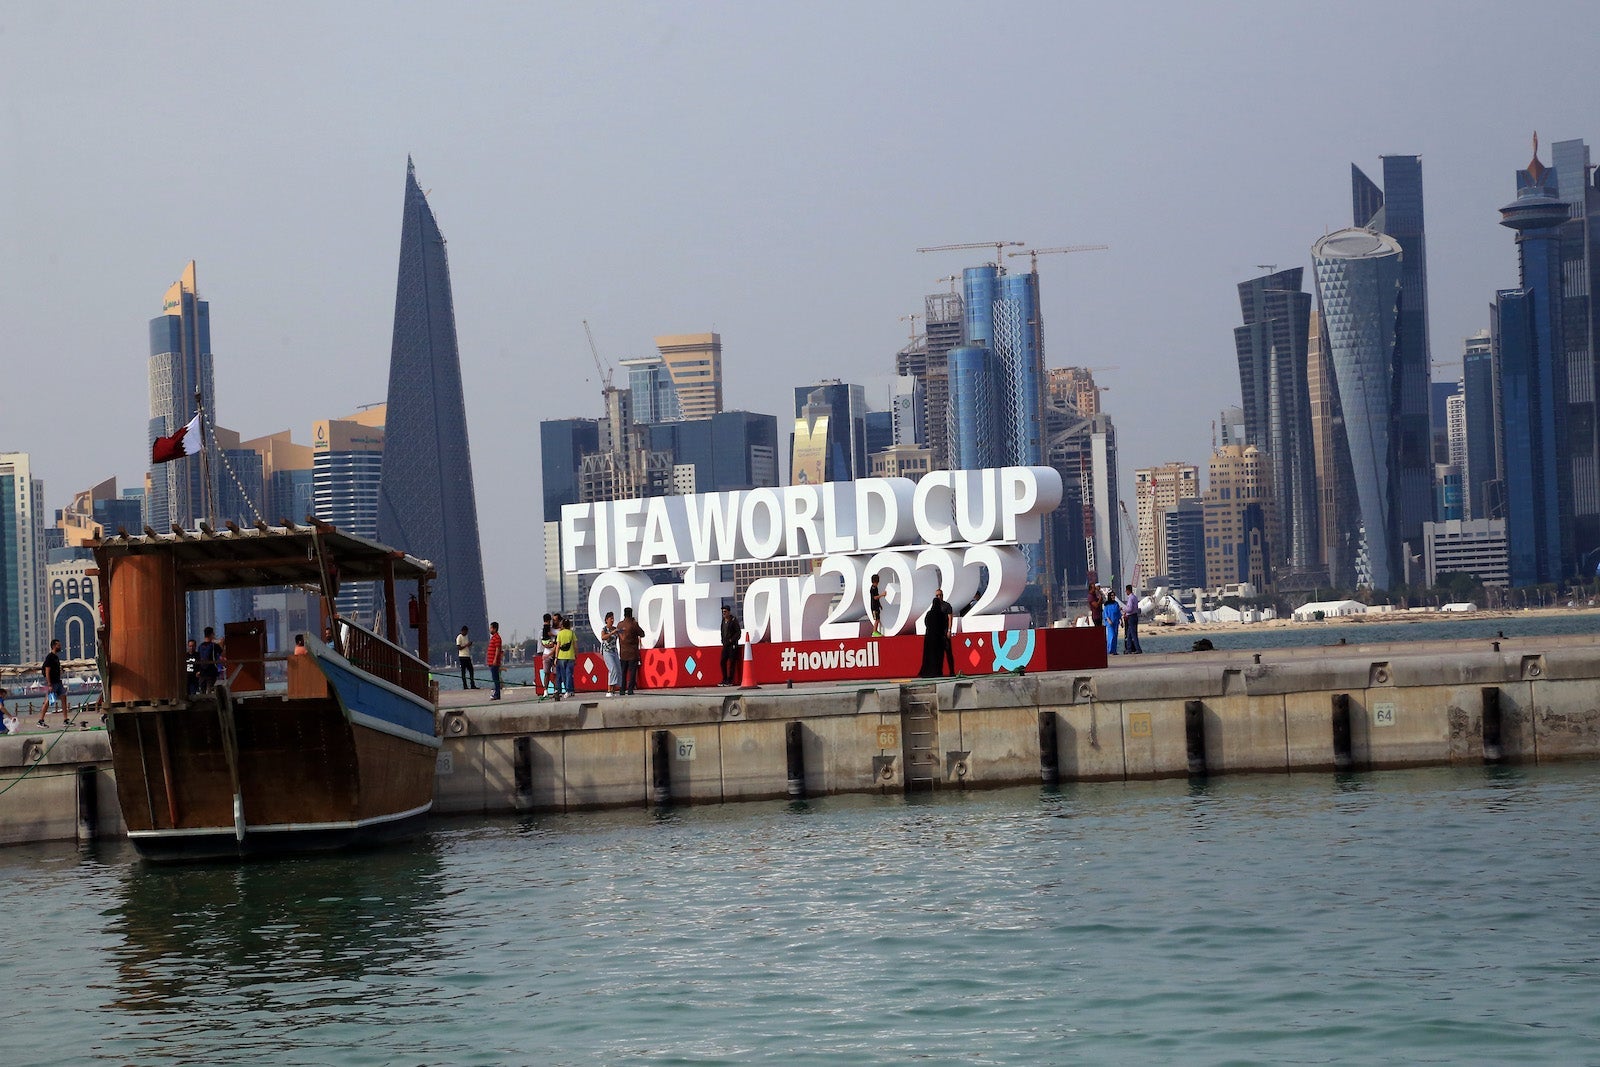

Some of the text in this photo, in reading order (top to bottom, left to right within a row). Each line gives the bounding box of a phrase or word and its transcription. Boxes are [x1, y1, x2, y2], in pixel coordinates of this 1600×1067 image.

[560, 466, 1038, 572] FIFA WORLD CUP
[780, 641, 880, 671] #nowisall
[1377, 709, 1392, 722] 64
[879, 732, 895, 745] 66
[679, 744, 693, 757] 67
